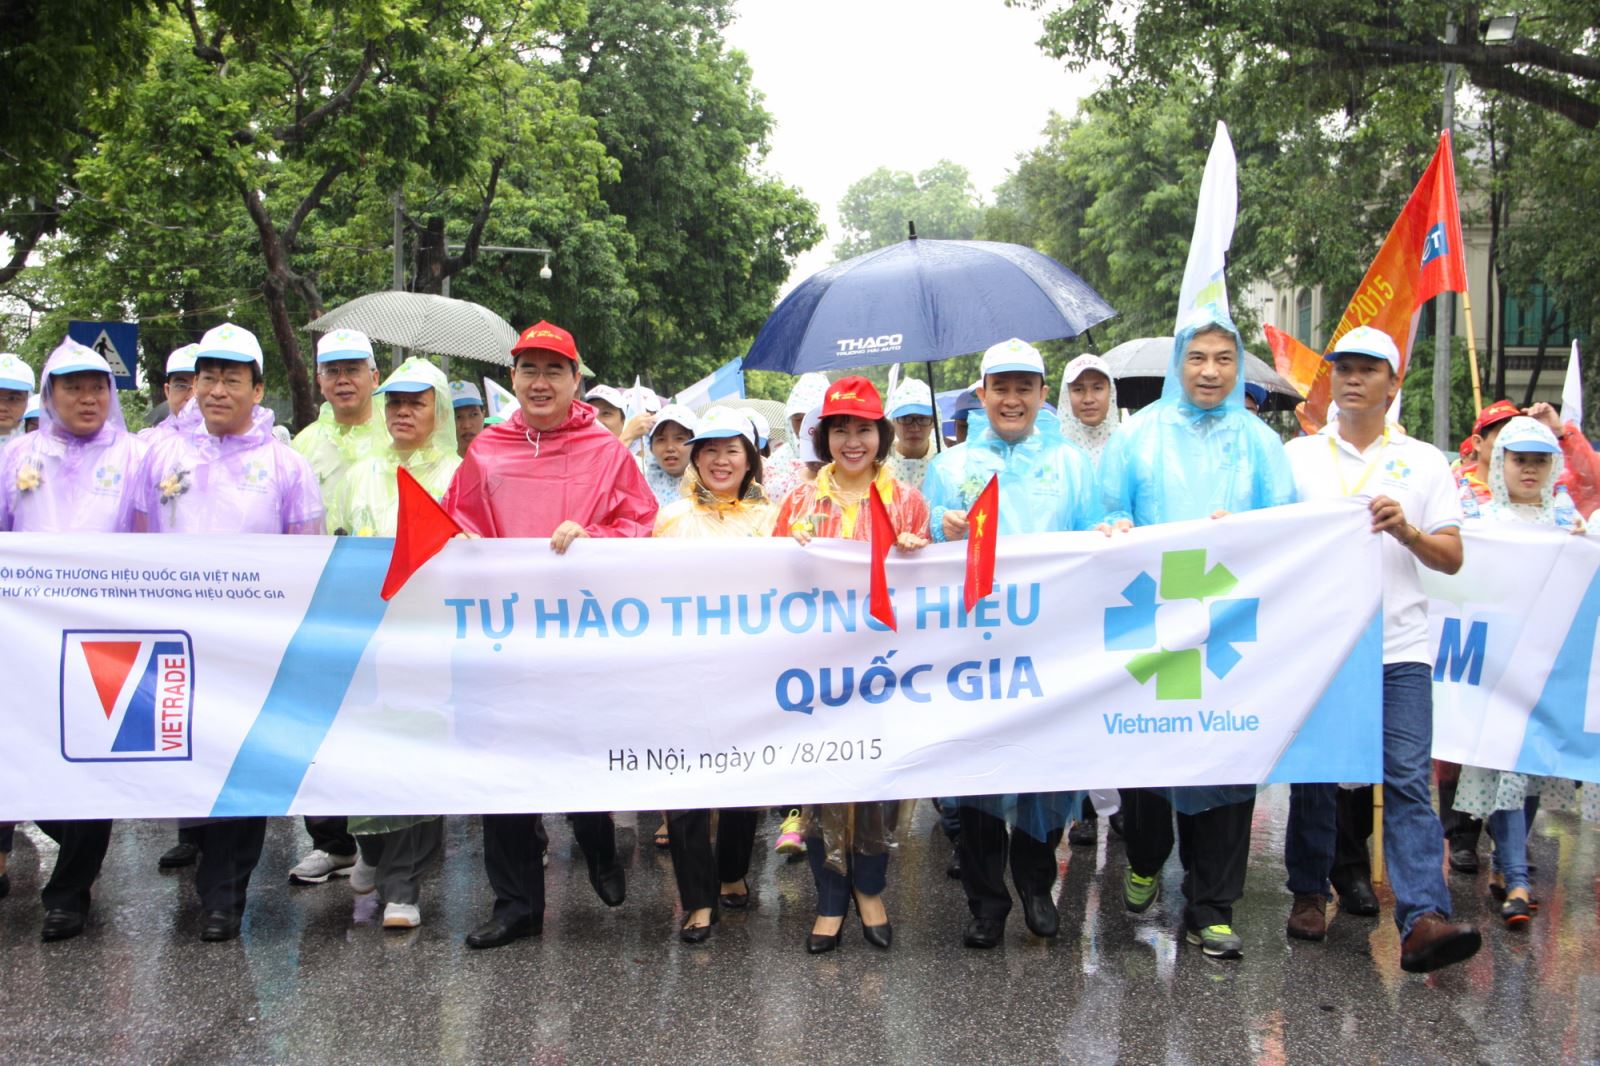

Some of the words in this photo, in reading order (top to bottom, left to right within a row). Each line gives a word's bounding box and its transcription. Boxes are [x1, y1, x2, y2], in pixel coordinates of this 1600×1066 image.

[1349, 275, 1395, 325] 2015
[837, 334, 903, 351] THACO
[55, 568, 109, 581] THƯƠNG
[111, 568, 139, 583] HIỆU
[142, 568, 177, 581] QUỐC
[180, 571, 201, 582] GIA
[203, 569, 229, 584] VIỆT
[232, 572, 260, 583] NAM
[0, 586, 22, 597] HƯ
[24, 585, 41, 598] KÝ
[43, 586, 98, 599] CHƯƠNG
[100, 586, 137, 598] TRÌNH
[139, 587, 193, 599] THƯƠNG
[195, 587, 224, 601] HIỆU
[226, 587, 262, 600] QUỐC
[264, 589, 286, 600] GIA
[444, 592, 519, 652] TỰ
[534, 590, 650, 639] HÀO
[775, 650, 934, 715] QUỐC
[946, 656, 1044, 702] GIA
[161, 657, 186, 752] VIETRADE
[1103, 713, 1193, 734] Vietnam
[1198, 710, 1260, 732] Value
[609, 749, 639, 771] Hà
[646, 748, 692, 775] Nội,
[699, 746, 756, 774] ngày
